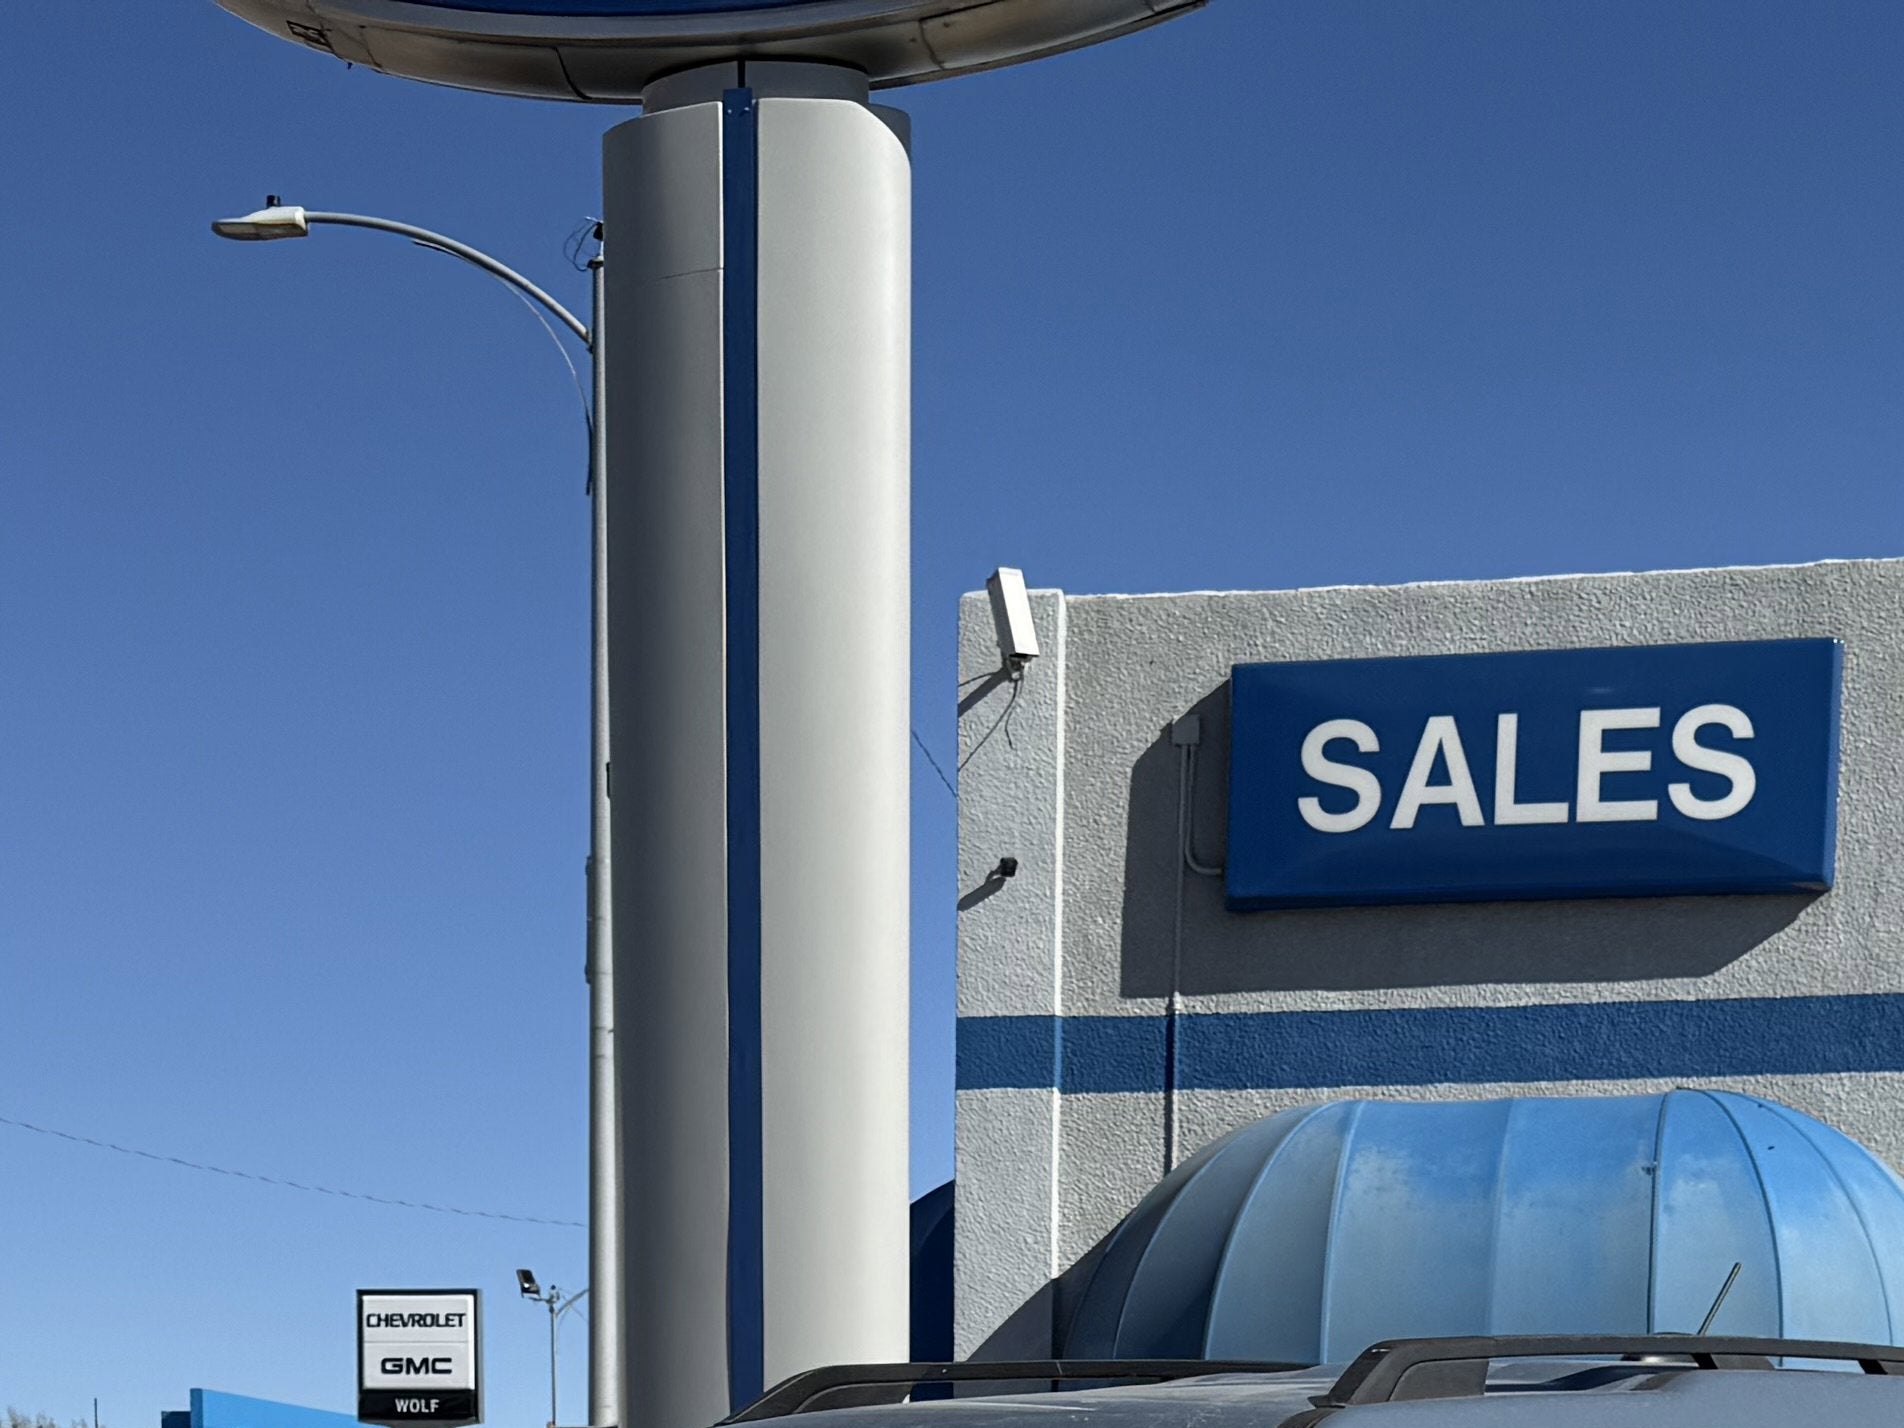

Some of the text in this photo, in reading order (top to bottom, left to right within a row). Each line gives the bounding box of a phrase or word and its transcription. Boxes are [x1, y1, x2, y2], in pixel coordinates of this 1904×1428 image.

[1297, 703, 1757, 834] SALES
[366, 1312, 467, 1328] CHEVROLET
[380, 1356, 453, 1375] GMC
[394, 1398, 440, 1413] WOLF
